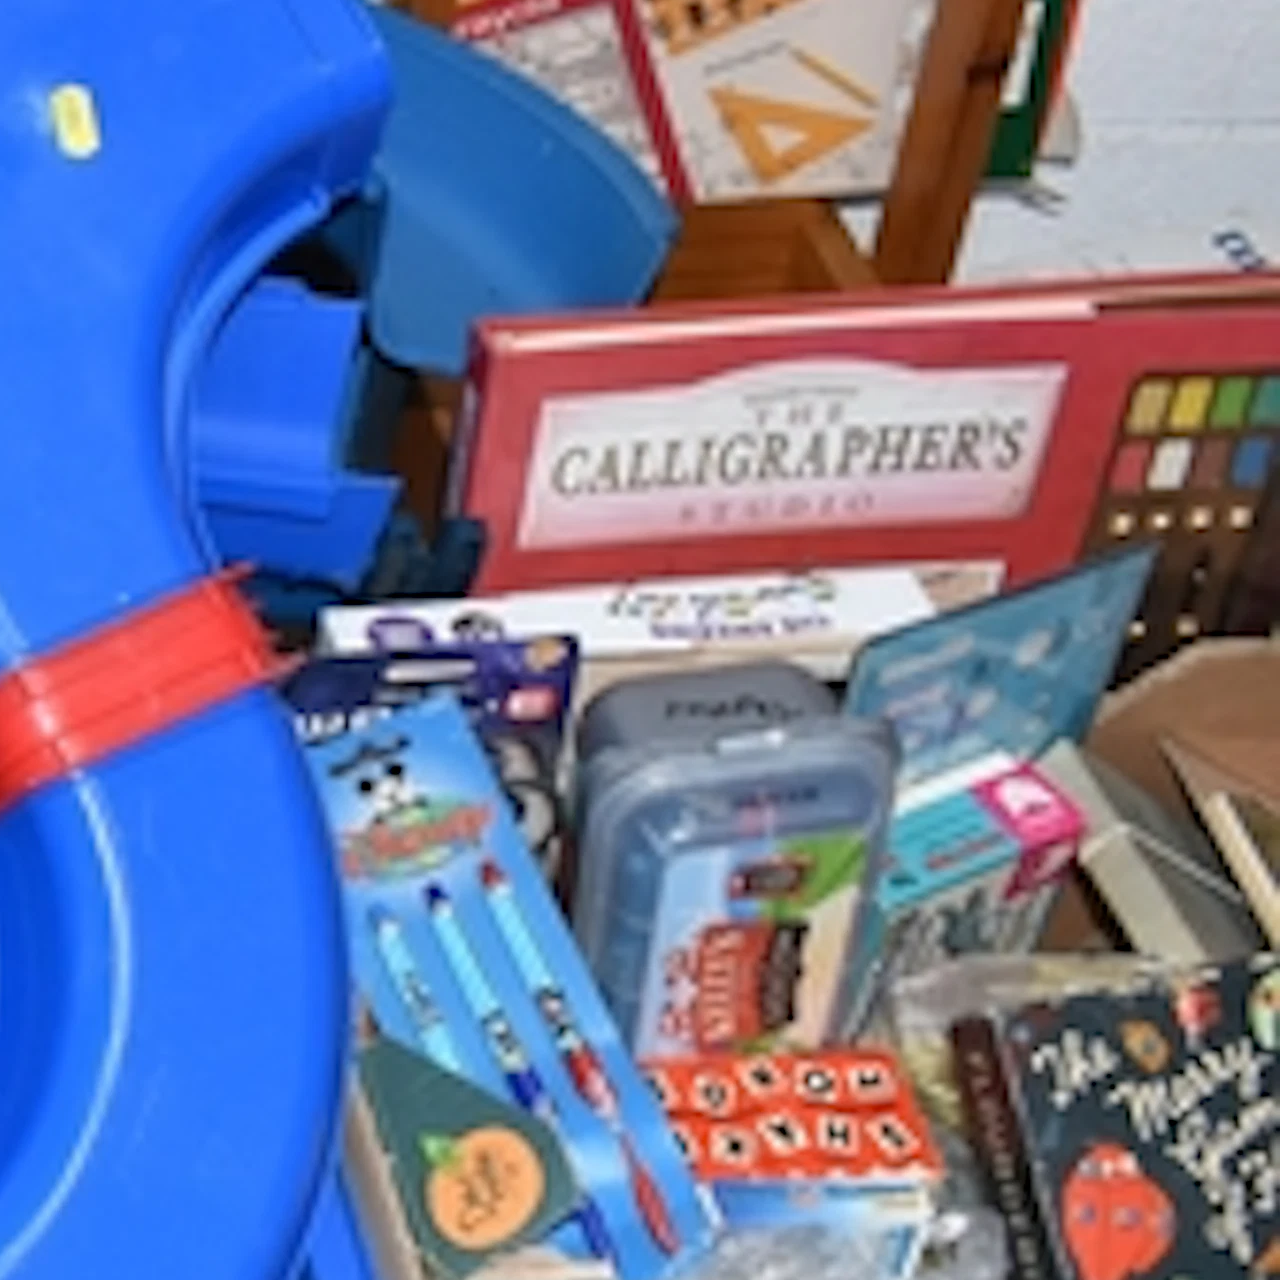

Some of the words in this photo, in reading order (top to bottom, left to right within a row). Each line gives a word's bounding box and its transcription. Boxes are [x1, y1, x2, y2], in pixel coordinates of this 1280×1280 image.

[756, 400, 844, 426] THE
[548, 412, 1028, 500] CALLIGRAPHER'S
[1029, 1027, 1122, 1111] The
